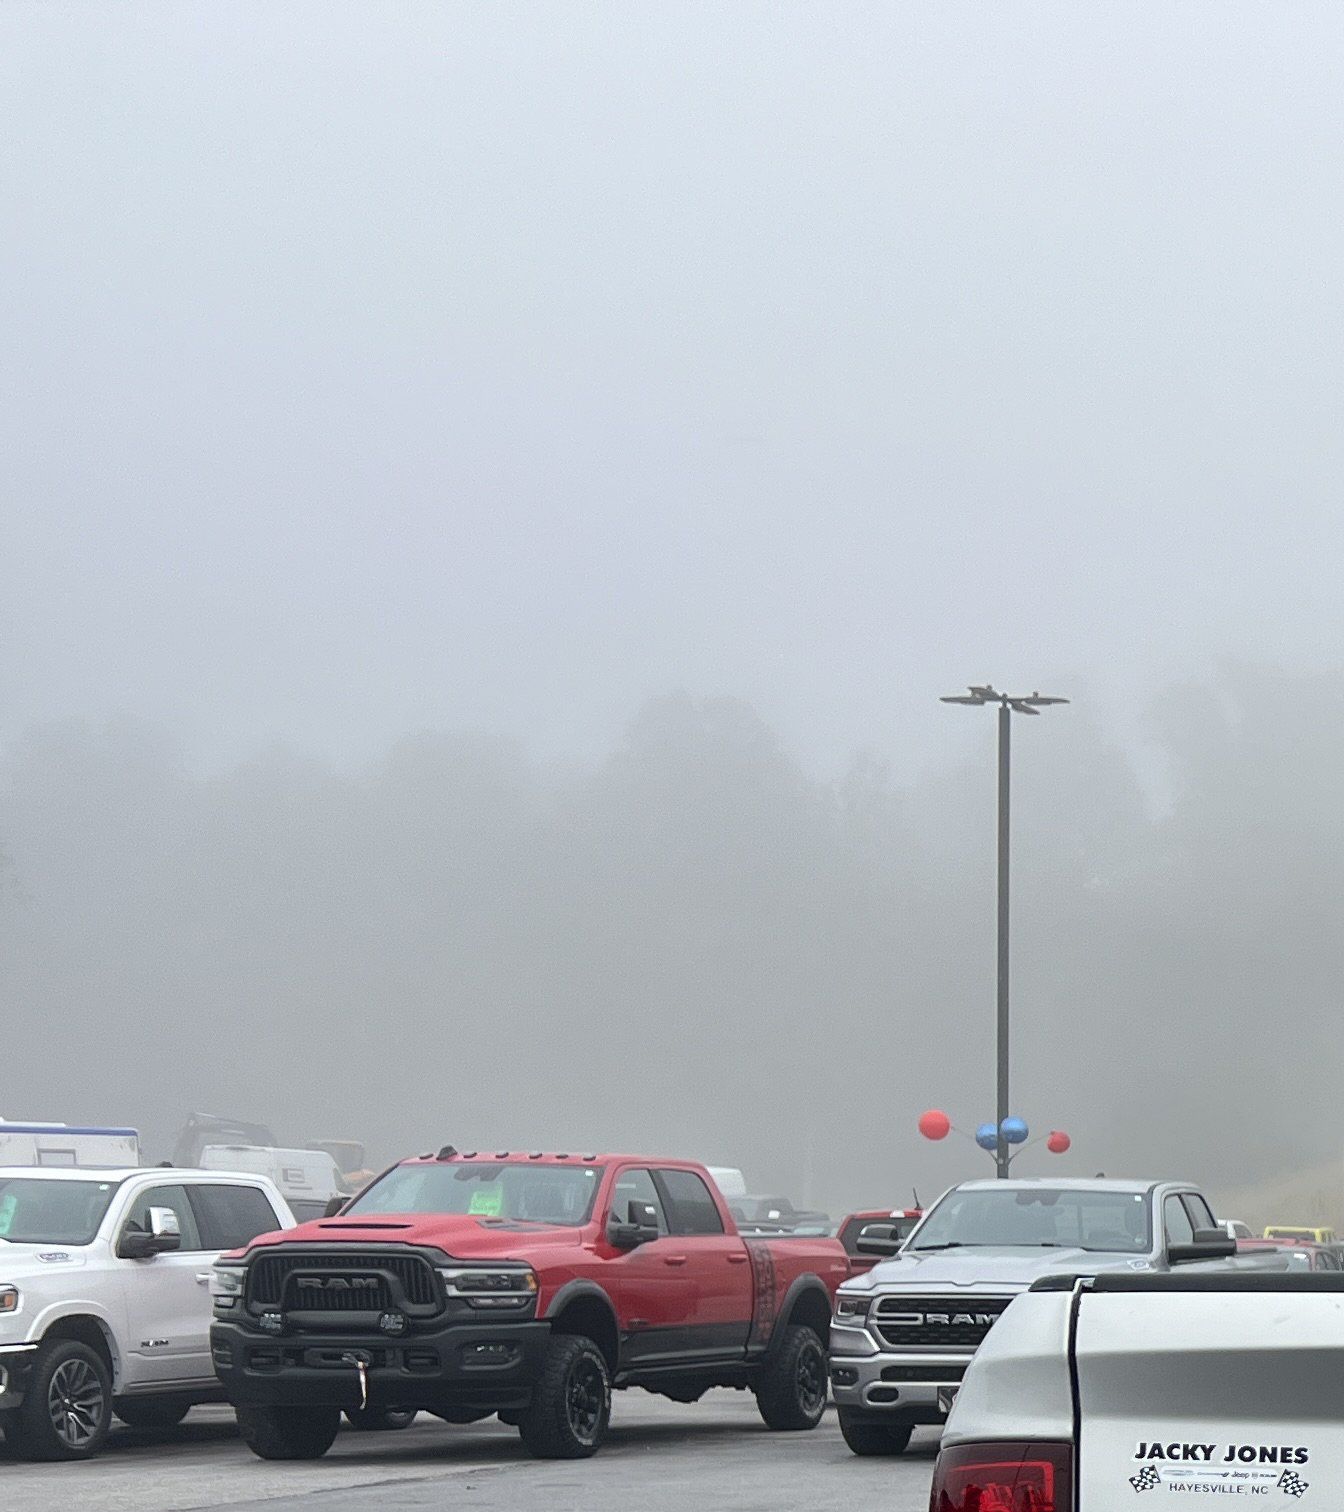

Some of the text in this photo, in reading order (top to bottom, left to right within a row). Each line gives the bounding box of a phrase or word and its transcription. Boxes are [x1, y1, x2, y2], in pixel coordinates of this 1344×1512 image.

[296, 1277, 380, 1290] RAM
[926, 1313, 1000, 1325] RAM
[1134, 1442, 1310, 1465] JACKY JONES
[1169, 1482, 1269, 1496] HAYESVILLE, NC
